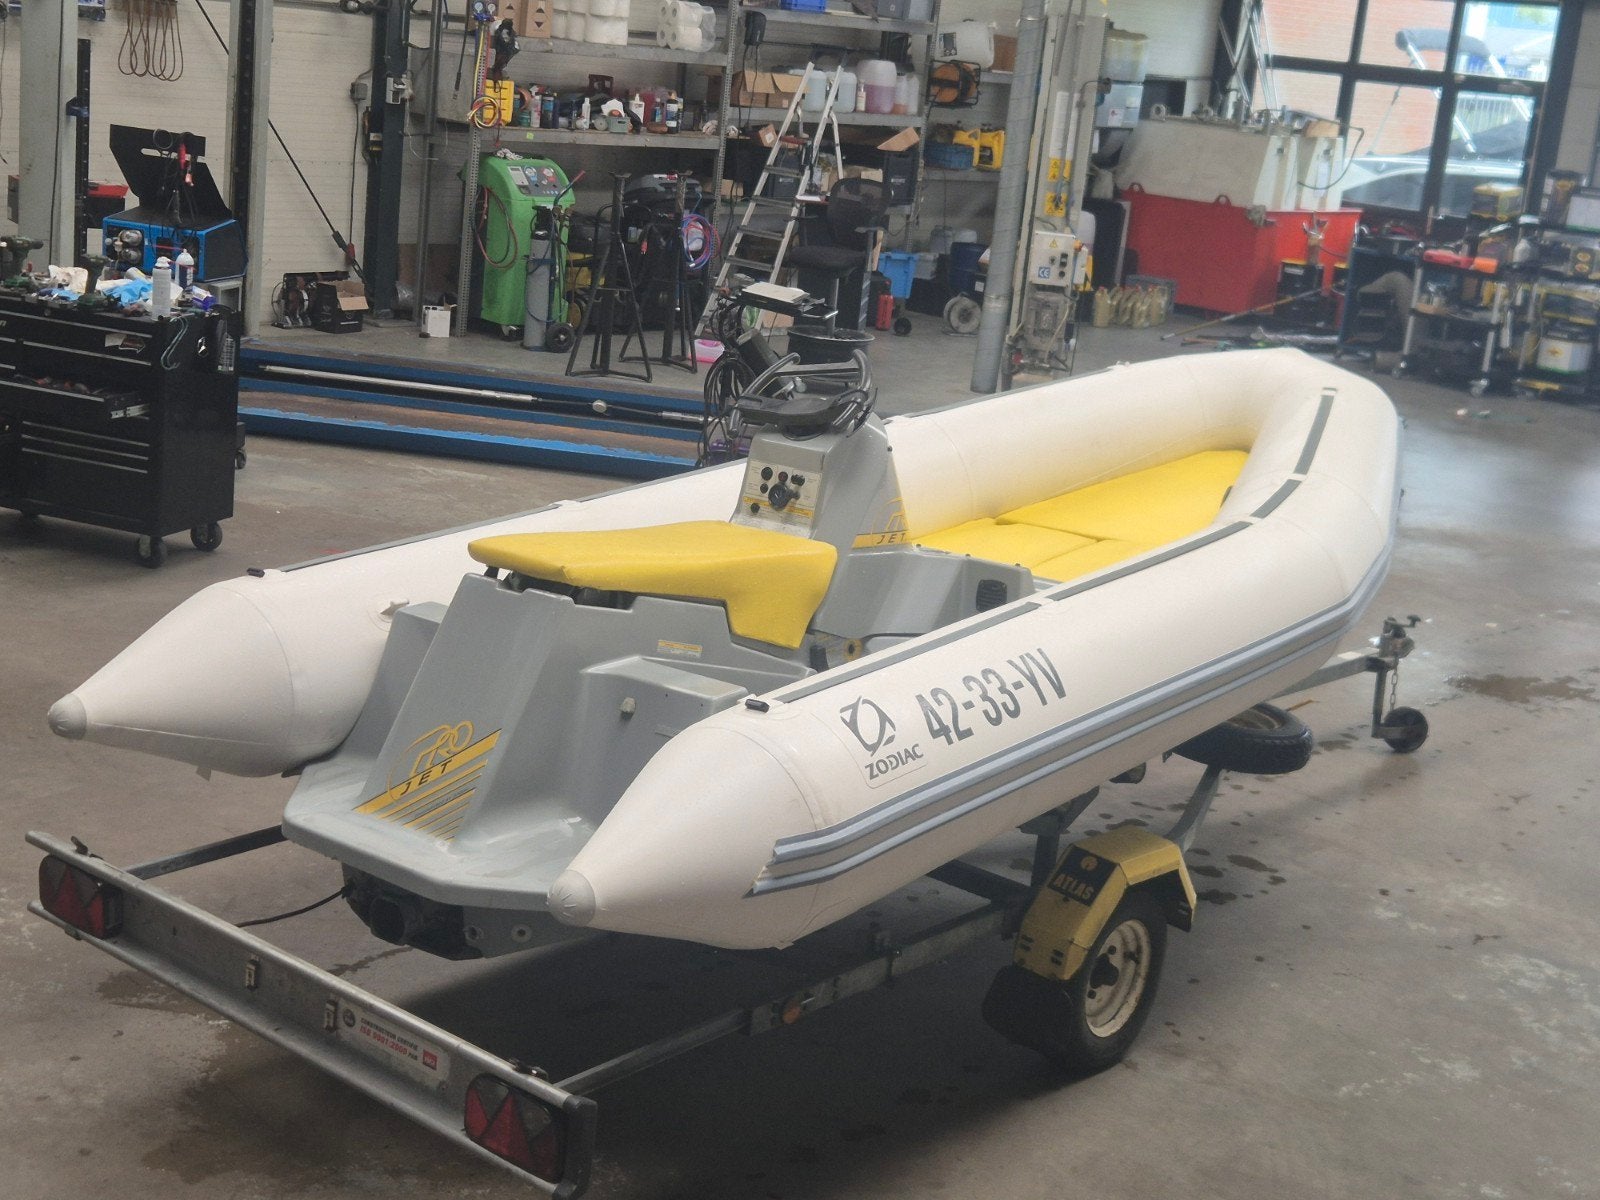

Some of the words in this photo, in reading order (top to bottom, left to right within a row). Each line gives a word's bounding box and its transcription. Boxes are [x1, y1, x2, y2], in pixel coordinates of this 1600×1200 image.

[876, 533, 907, 545] JET
[915, 648, 1067, 746] 42-33-YV
[865, 743, 924, 780] ZODIAC
[400, 759, 453, 796] JET
[1053, 873, 1095, 899] ATLAS
[360, 1025, 372, 1036] ISO
